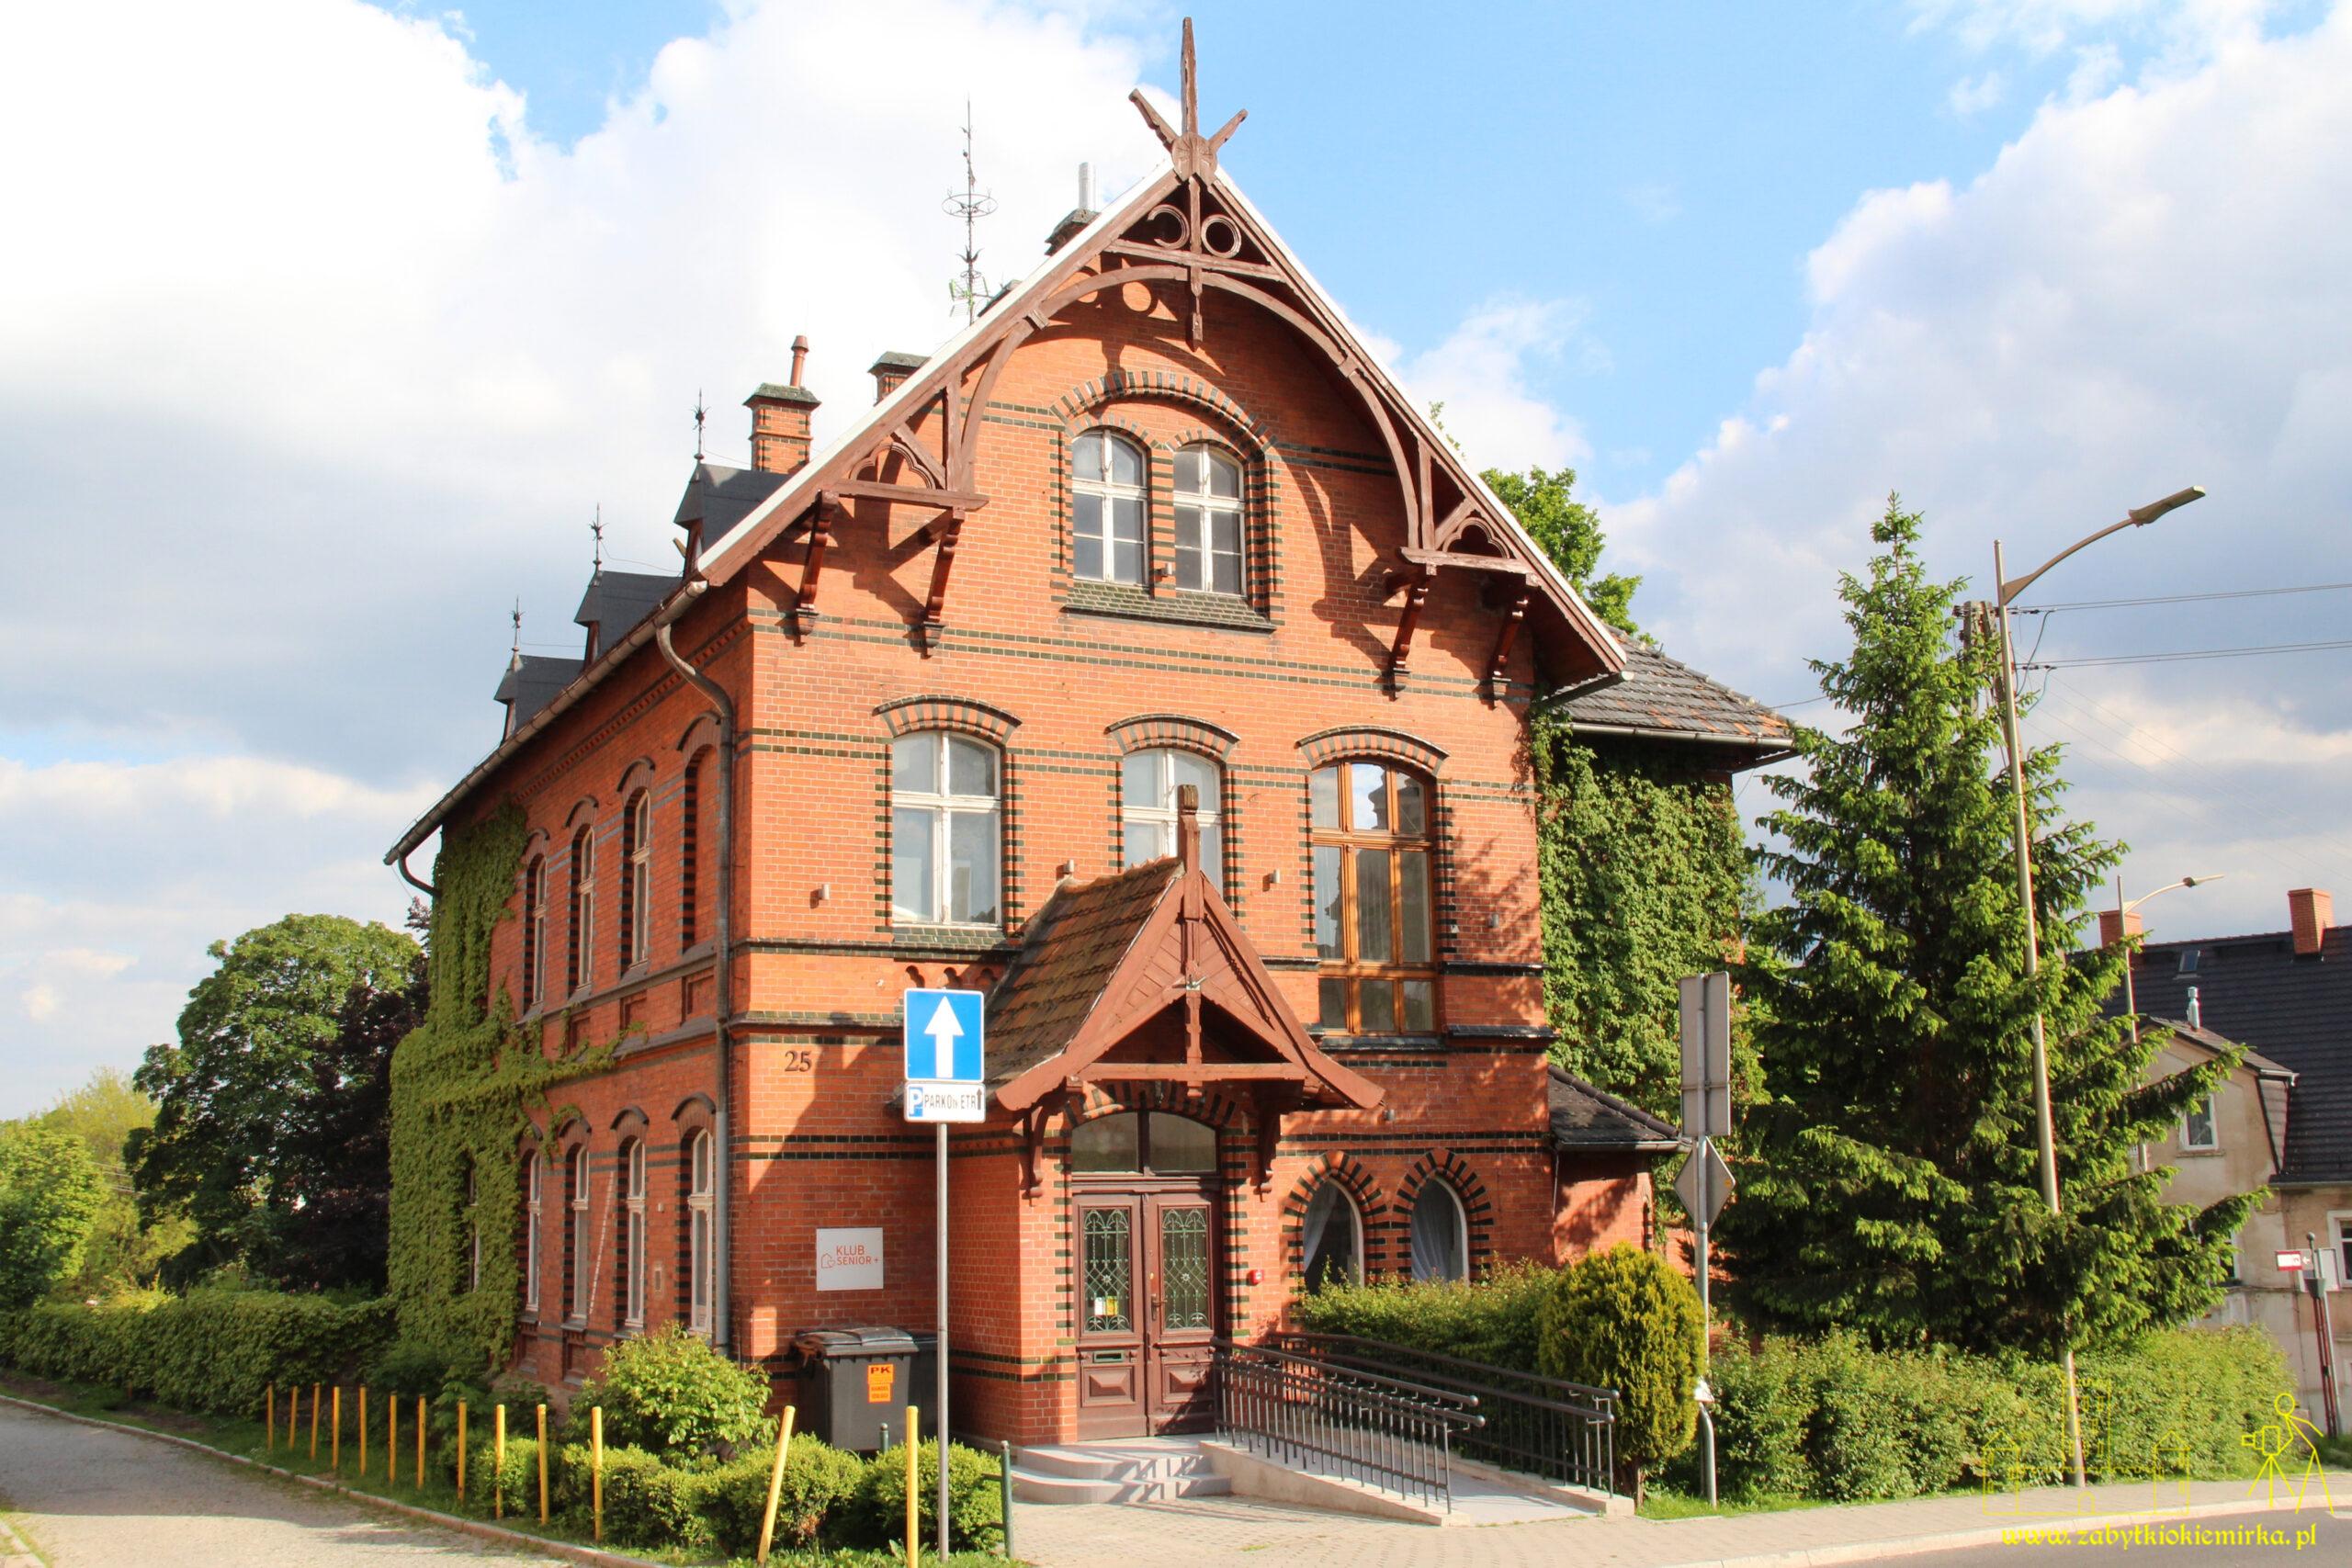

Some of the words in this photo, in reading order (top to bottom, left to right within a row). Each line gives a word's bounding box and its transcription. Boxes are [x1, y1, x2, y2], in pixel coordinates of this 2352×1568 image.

[785, 1050, 812, 1072] 25
[836, 1245, 865, 1256] KLUB
[837, 1256, 872, 1266] SENIOR
[870, 1366, 890, 1374] PK
